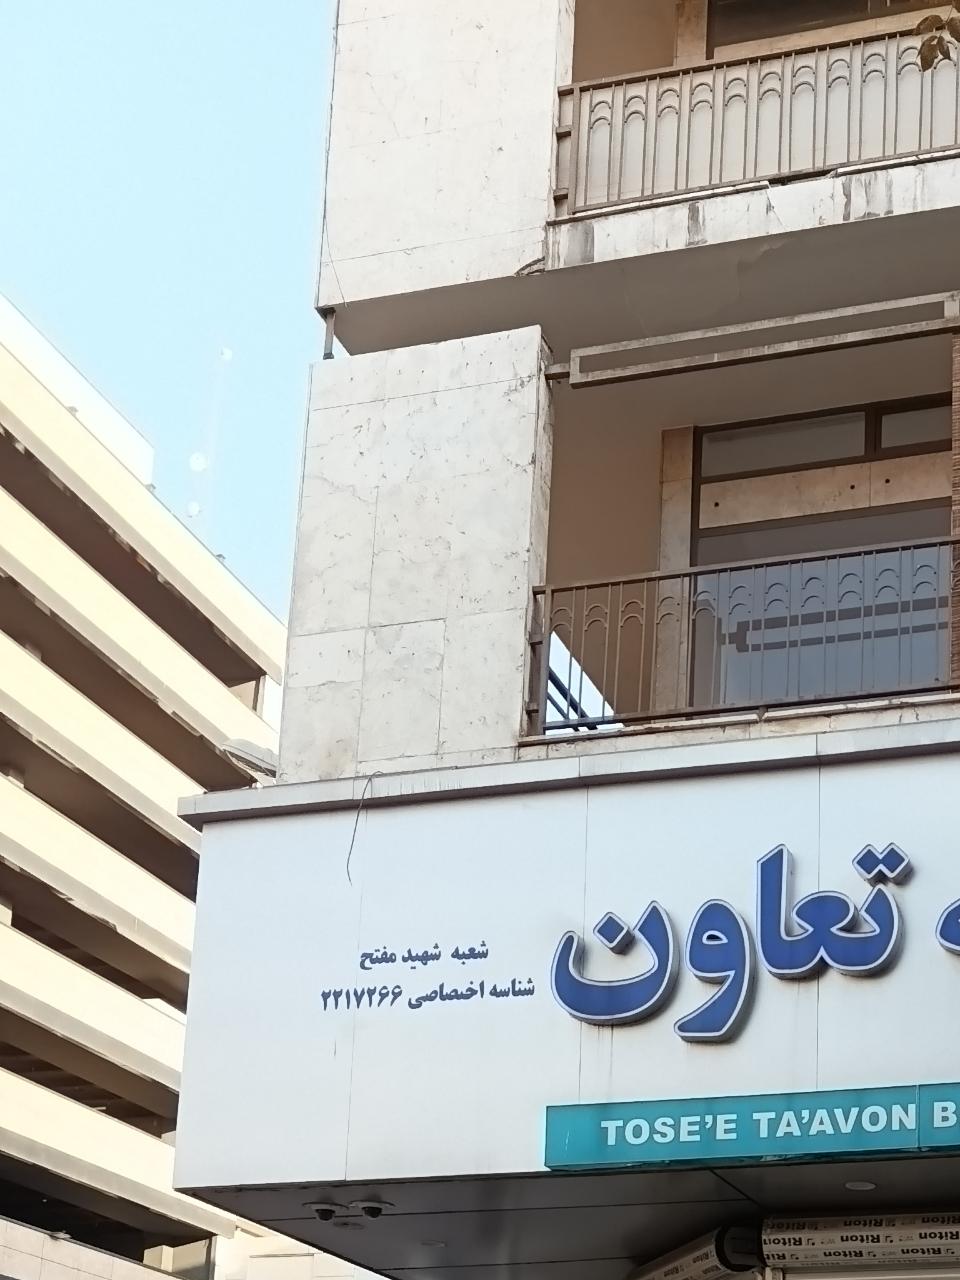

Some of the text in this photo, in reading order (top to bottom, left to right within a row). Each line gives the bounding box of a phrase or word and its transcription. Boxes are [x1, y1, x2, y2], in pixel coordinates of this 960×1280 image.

[359, 940, 489, 971] شعبه شهید مفتح
[551, 841, 915, 1043] تعاون
[321, 985, 403, 1011] ۲۲۱۷۲۶۶
[489, 978, 536, 999] شناسه
[600, 1113, 738, 1147] TOSE'E
[752, 1103, 917, 1140] TA'AVON
